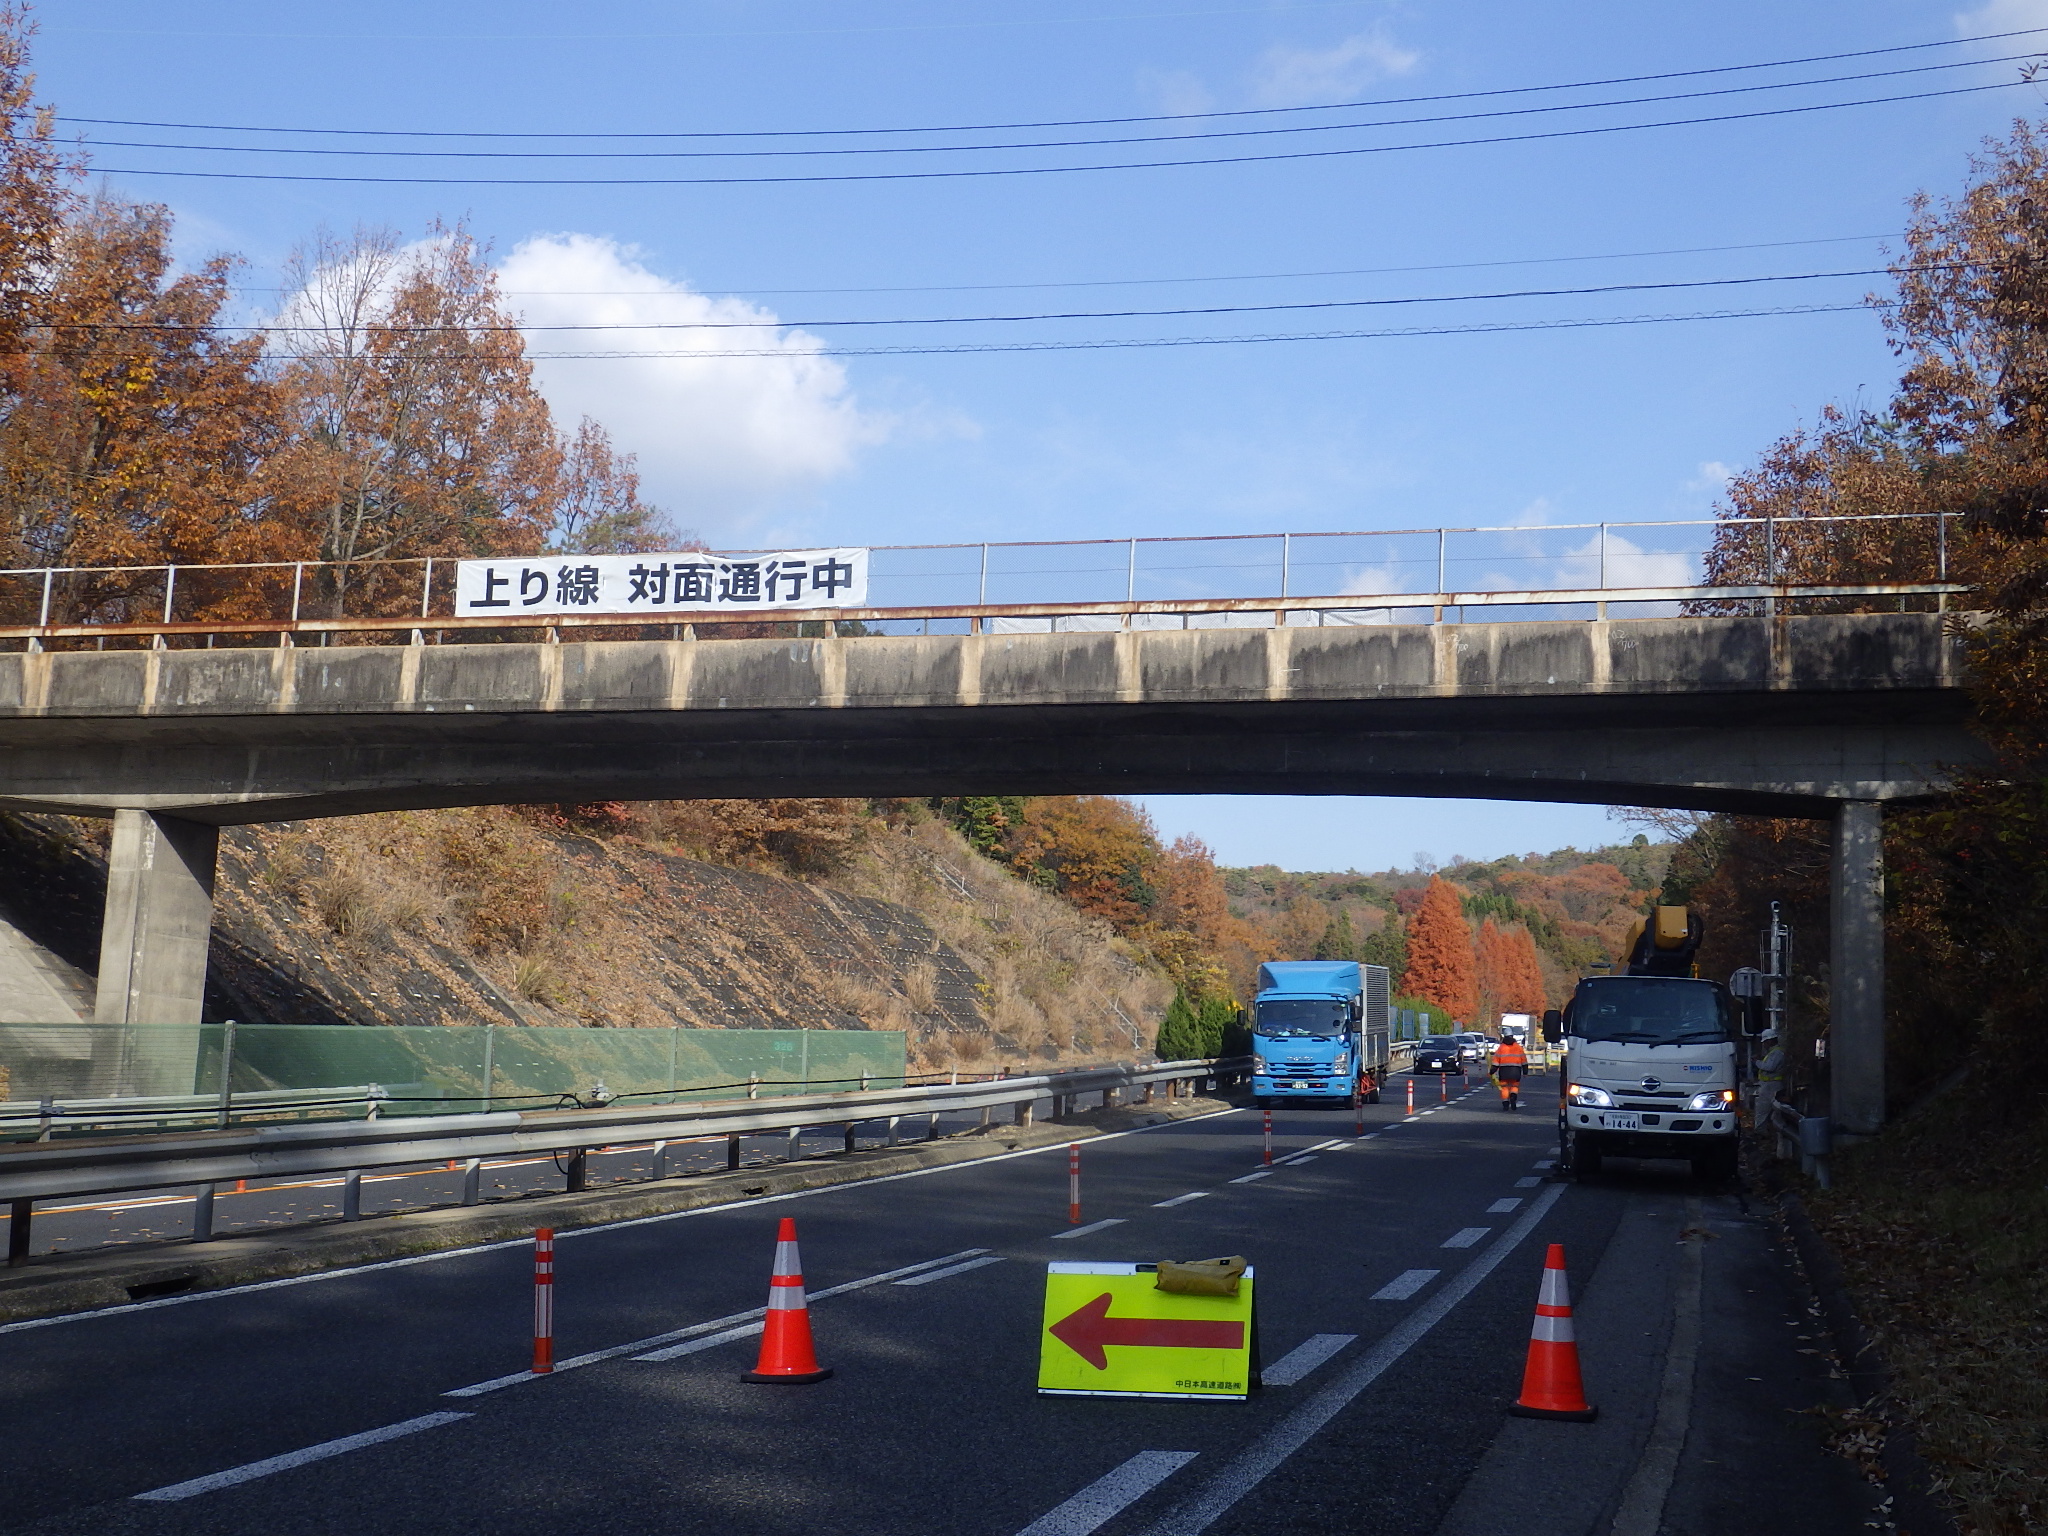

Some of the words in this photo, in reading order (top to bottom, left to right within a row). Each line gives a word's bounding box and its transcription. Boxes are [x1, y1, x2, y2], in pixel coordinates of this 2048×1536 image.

[470, 564, 600, 608] 上り線
[628, 558, 853, 605] 対面通行中
[1612, 1119, 1637, 1129] 14-44
